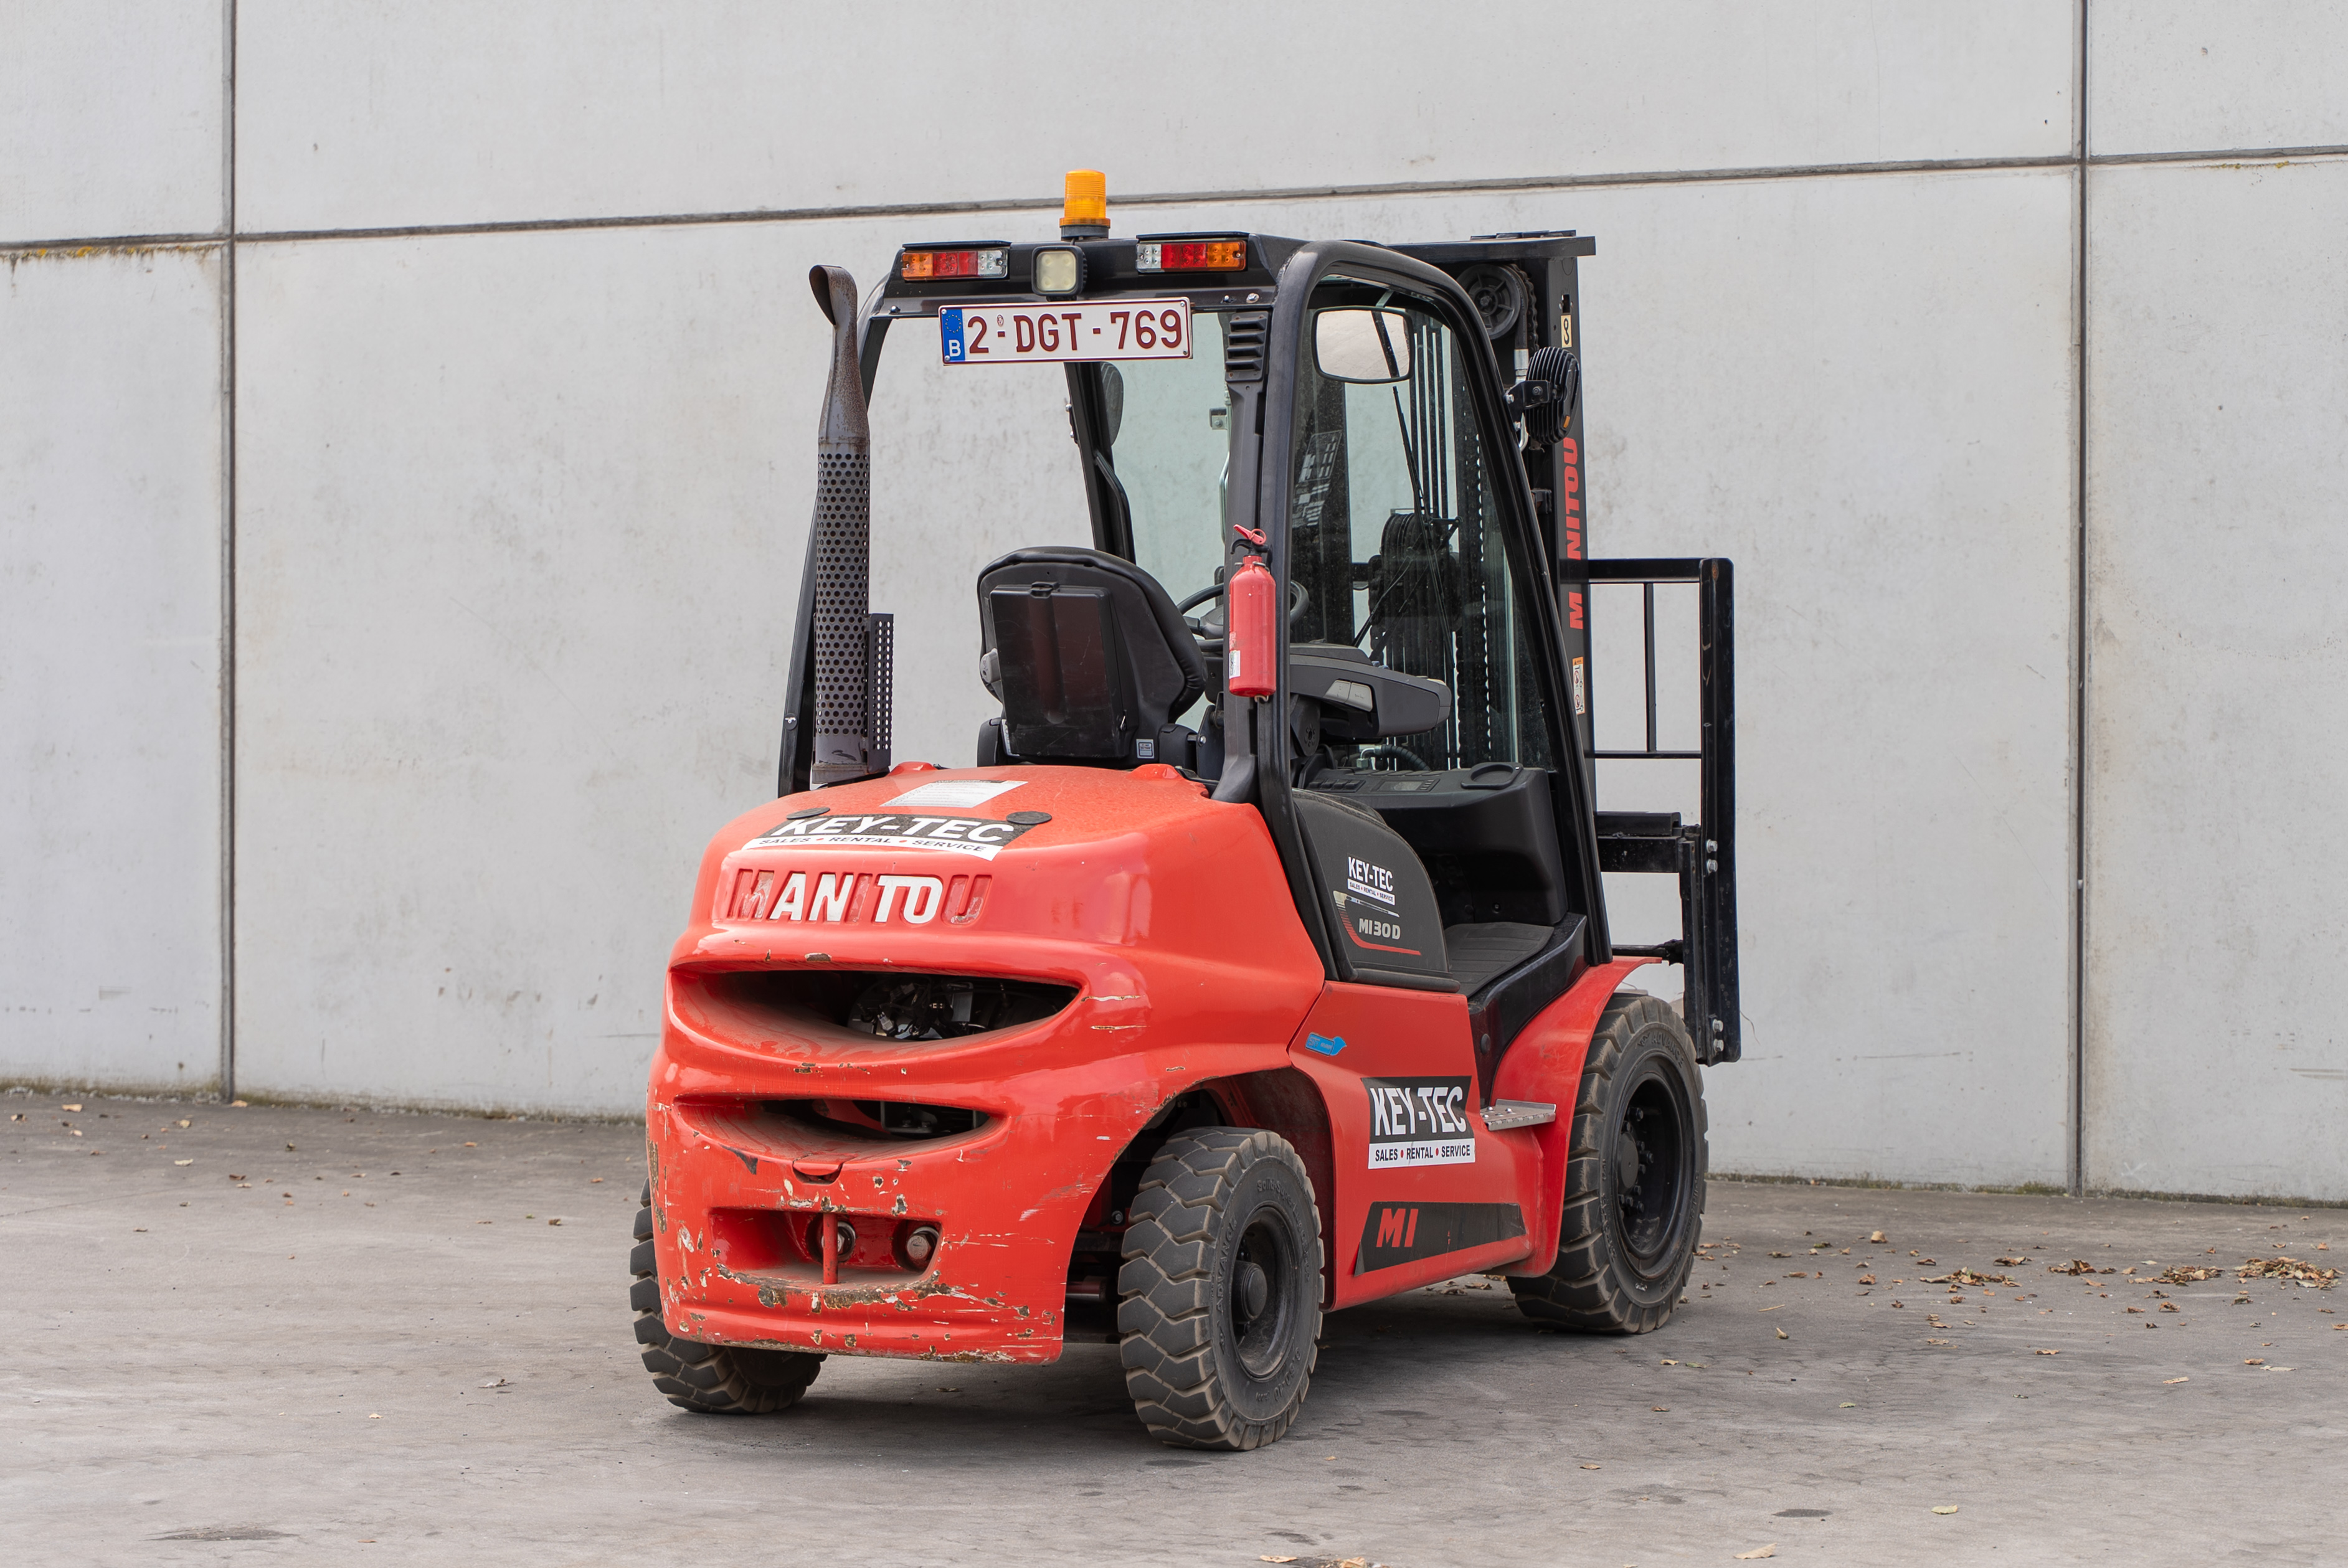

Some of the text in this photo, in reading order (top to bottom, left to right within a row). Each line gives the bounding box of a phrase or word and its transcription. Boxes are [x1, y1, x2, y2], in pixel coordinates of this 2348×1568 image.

[948, 339, 961, 357] B
[1563, 437, 1583, 630] MNITOU
[770, 817, 1014, 843] KEY-TEC
[912, 840, 987, 852] SERVICE
[1348, 856, 1393, 892] KEY-TEC
[1350, 882, 1393, 902] SALES RENTAL SERVICE
[1370, 1085, 1467, 1136] KEY-TEC
[1375, 1145, 1470, 1162] SALES RENTAL SERVICE
[1376, 1208, 1419, 1248] MI
